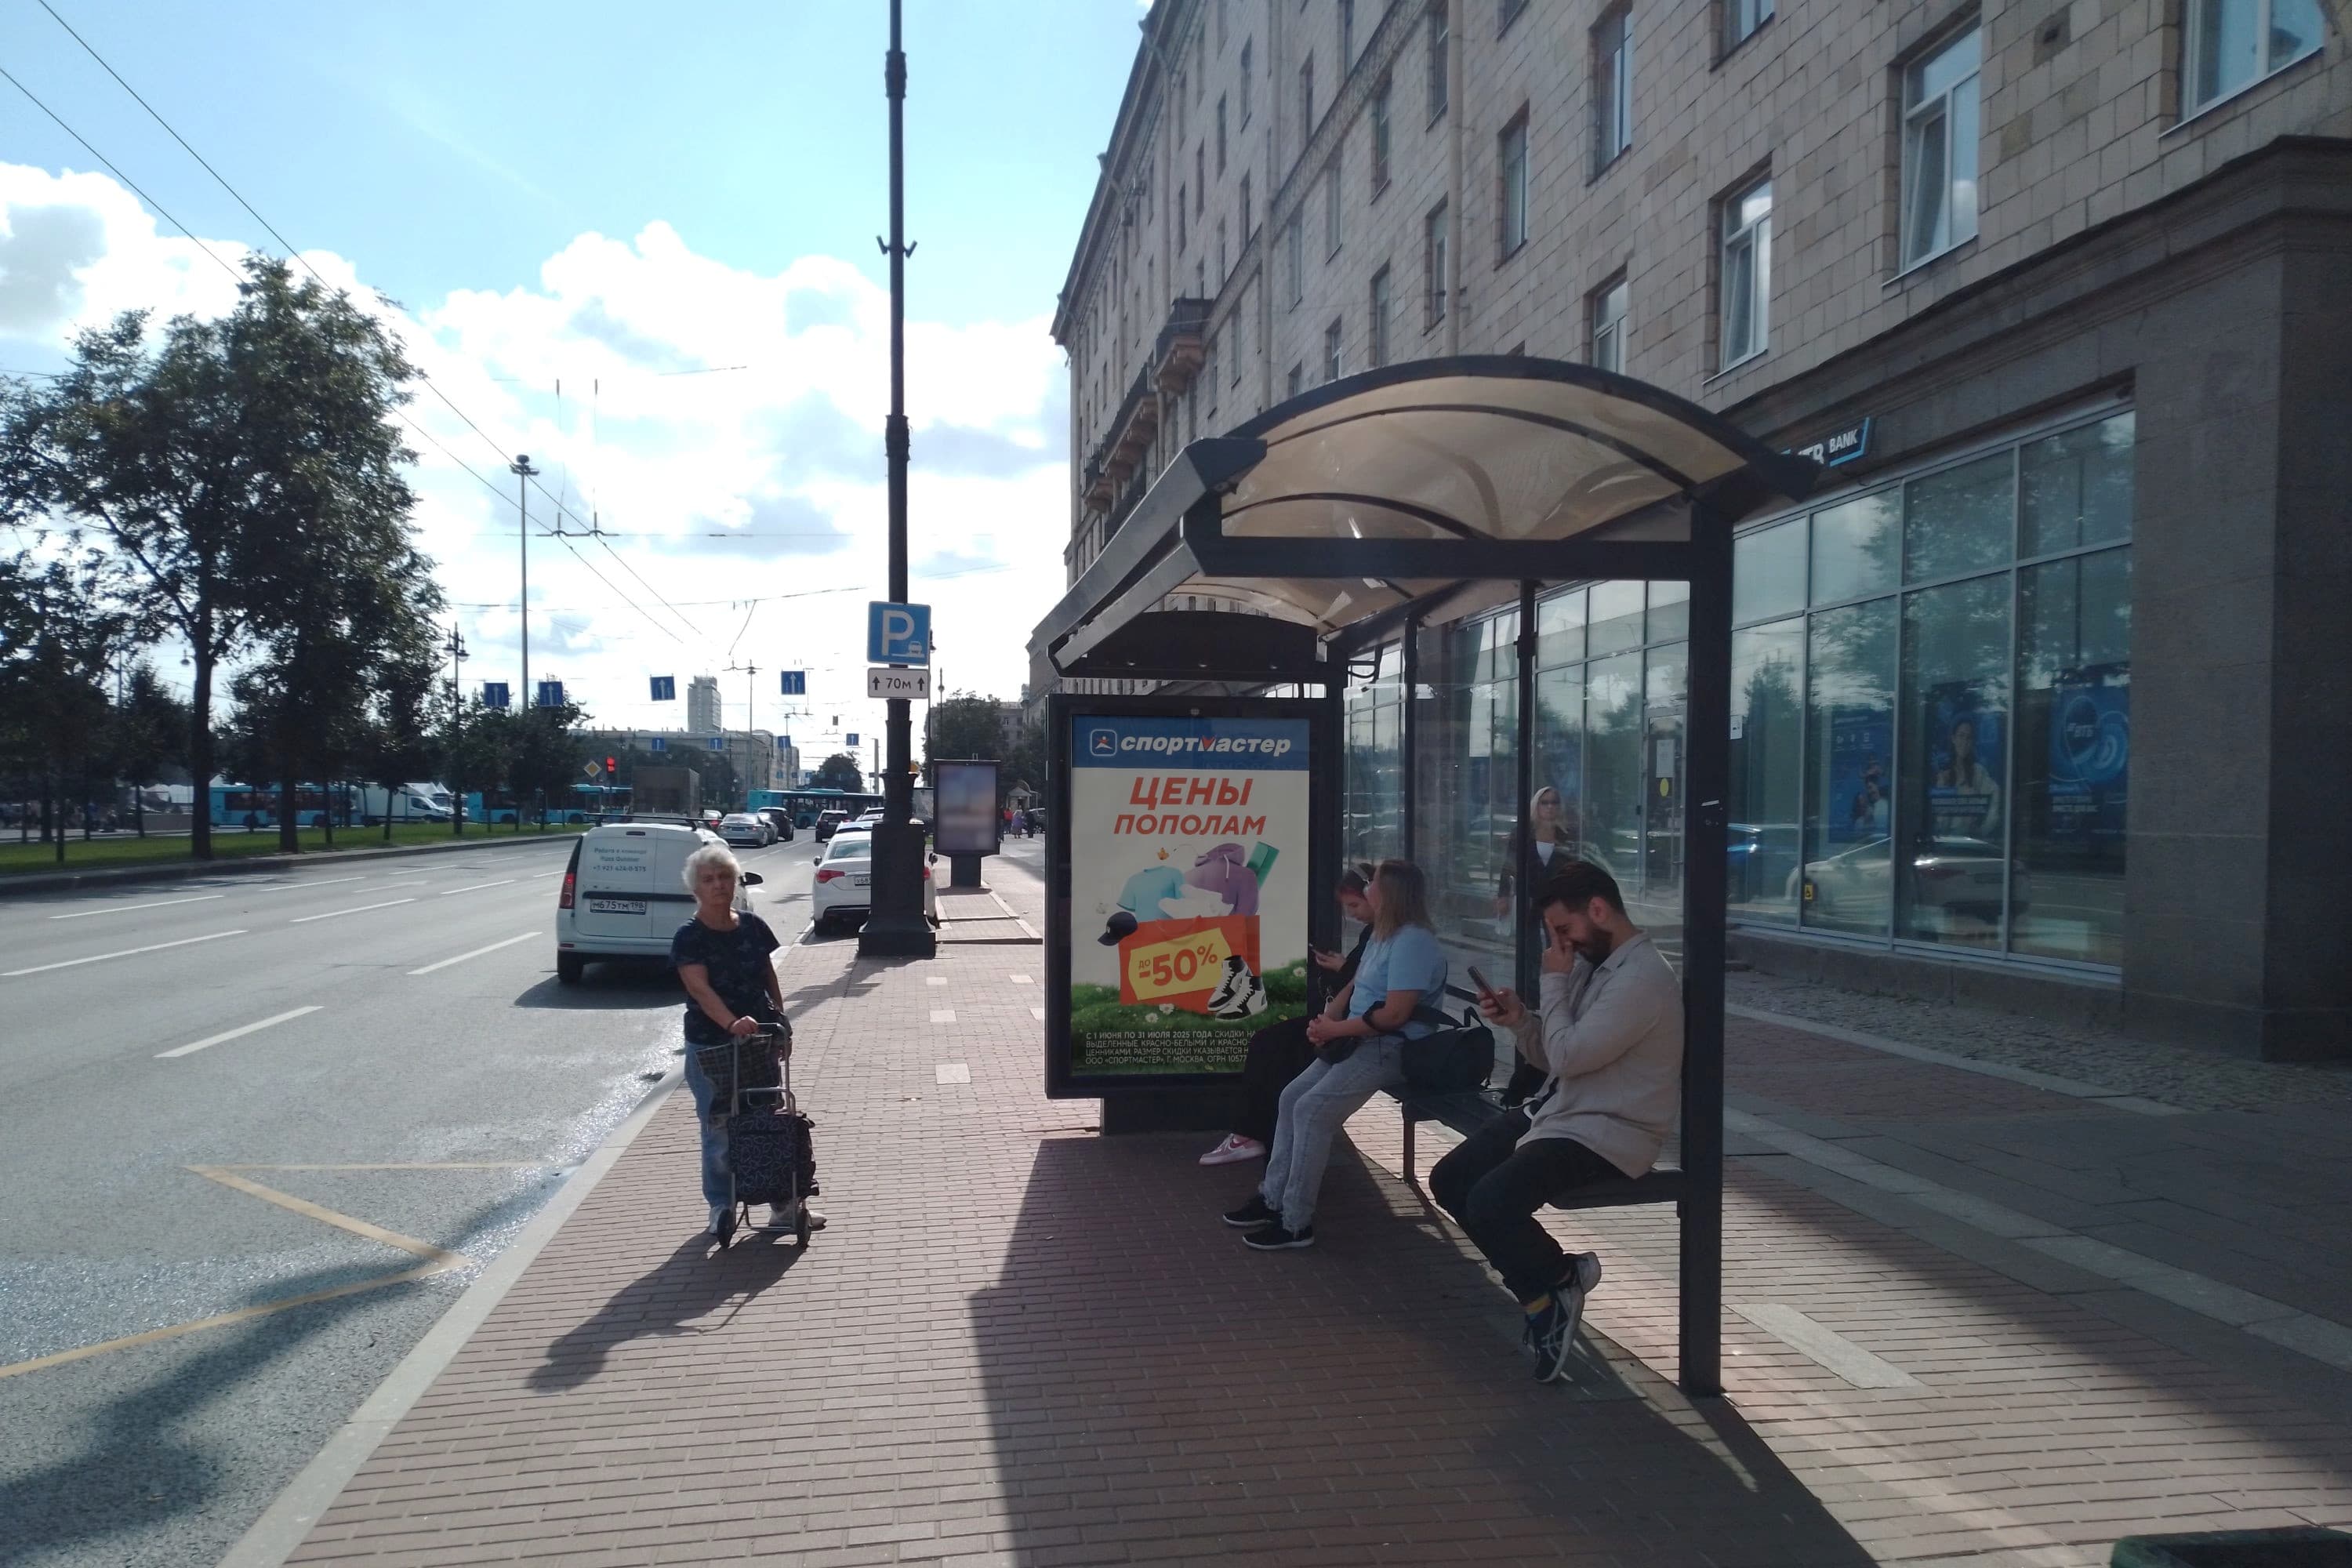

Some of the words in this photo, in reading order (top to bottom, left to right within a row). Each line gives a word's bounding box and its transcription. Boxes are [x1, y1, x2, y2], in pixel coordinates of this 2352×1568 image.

[1829, 429, 1858, 453] BANK
[881, 609, 915, 656] P
[1121, 735, 1291, 757] спортмастер
[1129, 776, 1254, 811] ЦЕНЫ
[1113, 814, 1267, 836] ПОПОЛАМ
[1139, 943, 1218, 987] -50%
[1086, 1040, 1139, 1048] ВЫДЕЛЕННЫЕ
[1141, 1039, 1207, 1047] КРАСНО-БЕЛЫМИ
[1192, 1030, 1212, 1039] ГОДА
[1215, 1030, 1244, 1039] СКИДКИ
[1192, 1047, 1243, 1055] УКАЗЫВАЕТСЯ
